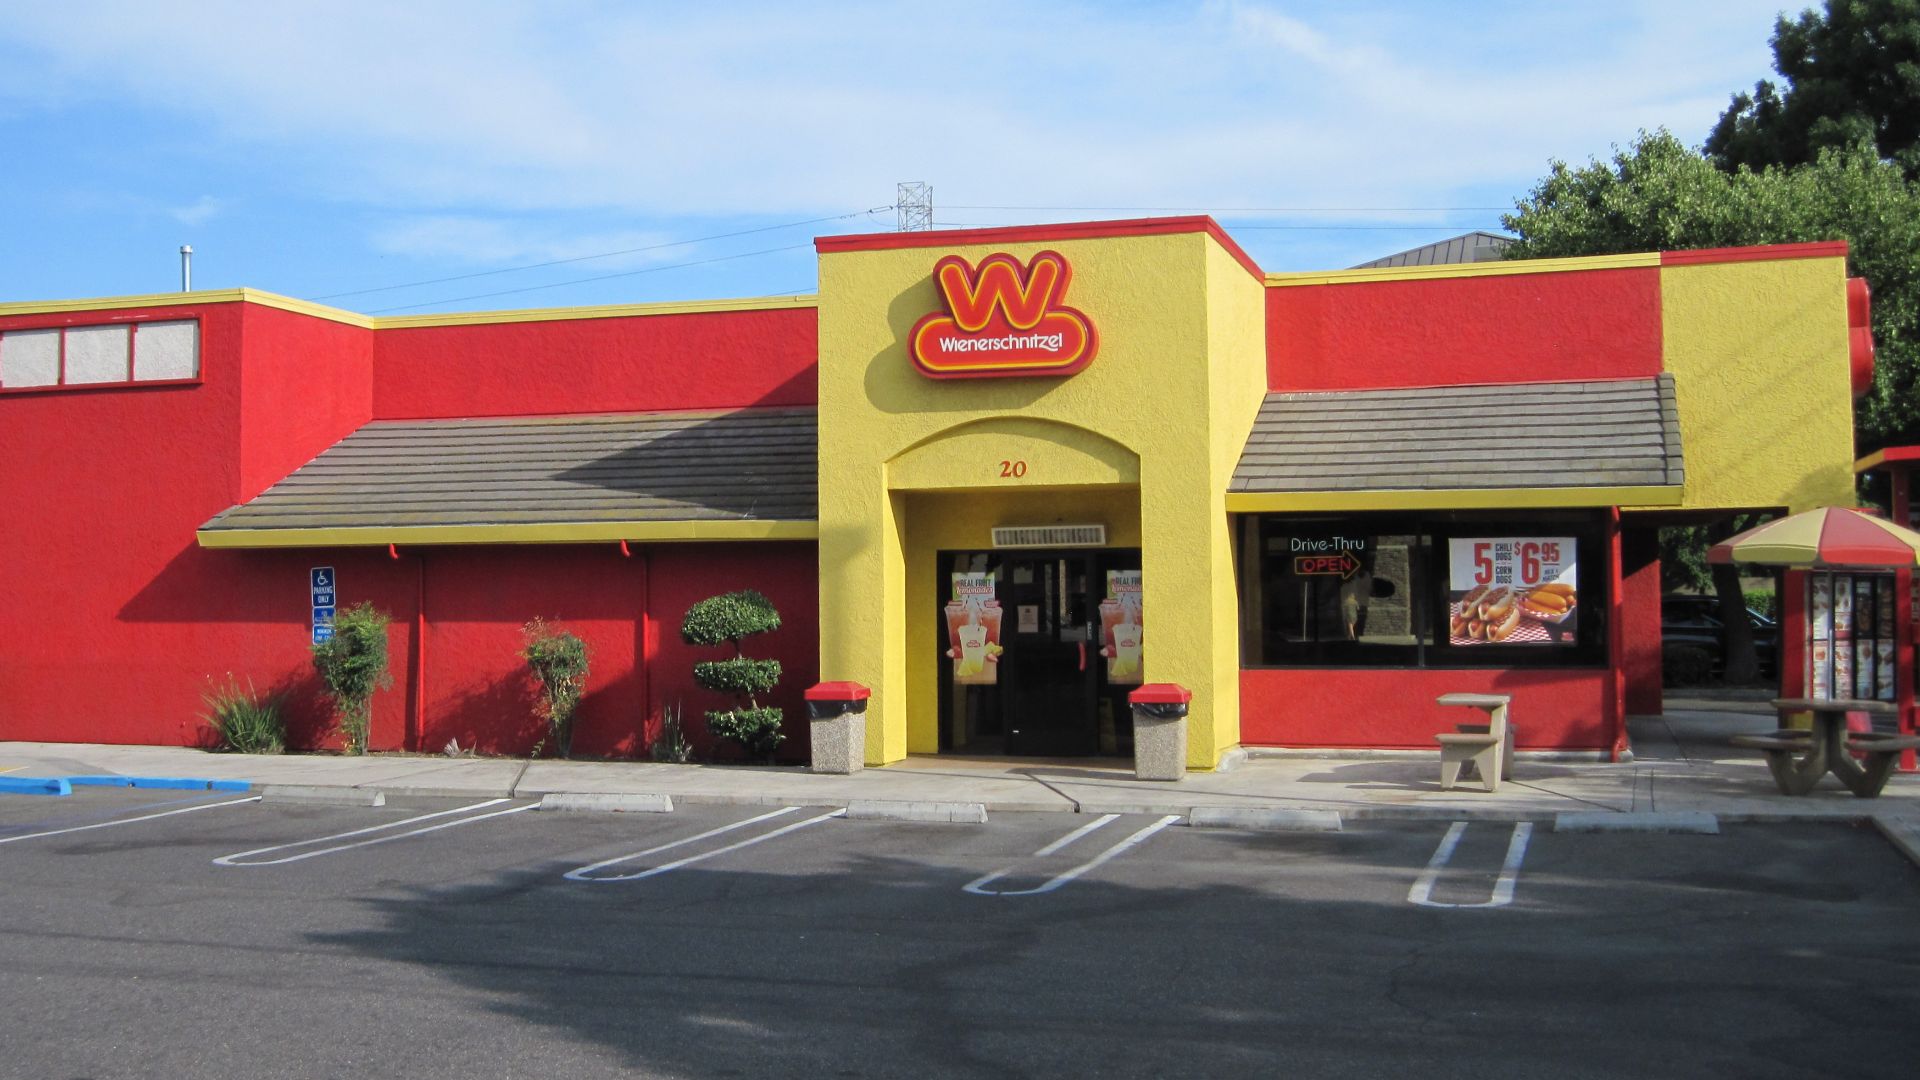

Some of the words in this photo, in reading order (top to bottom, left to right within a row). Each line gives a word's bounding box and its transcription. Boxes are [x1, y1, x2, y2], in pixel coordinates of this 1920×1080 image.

[940, 258, 1058, 331] W
[939, 332, 1063, 352] Wienerschnitzel
[999, 460, 1027, 478] 20
[1291, 536, 1364, 552] Drive-Thru
[1495, 543, 1512, 552] CHILI
[1495, 552, 1512, 561] DOGS
[1303, 558, 1352, 573] OPEN
[1474, 543, 1493, 585] 5
[1495, 566, 1512, 575] CORN
[960, 579, 974, 588] REAL
[975, 579, 992, 588] FRUIT
[1115, 576, 1129, 585] REAL
[1495, 575, 1512, 584] DOGS
[313, 586, 333, 595] PARKING
[317, 595, 330, 604] ONLY
